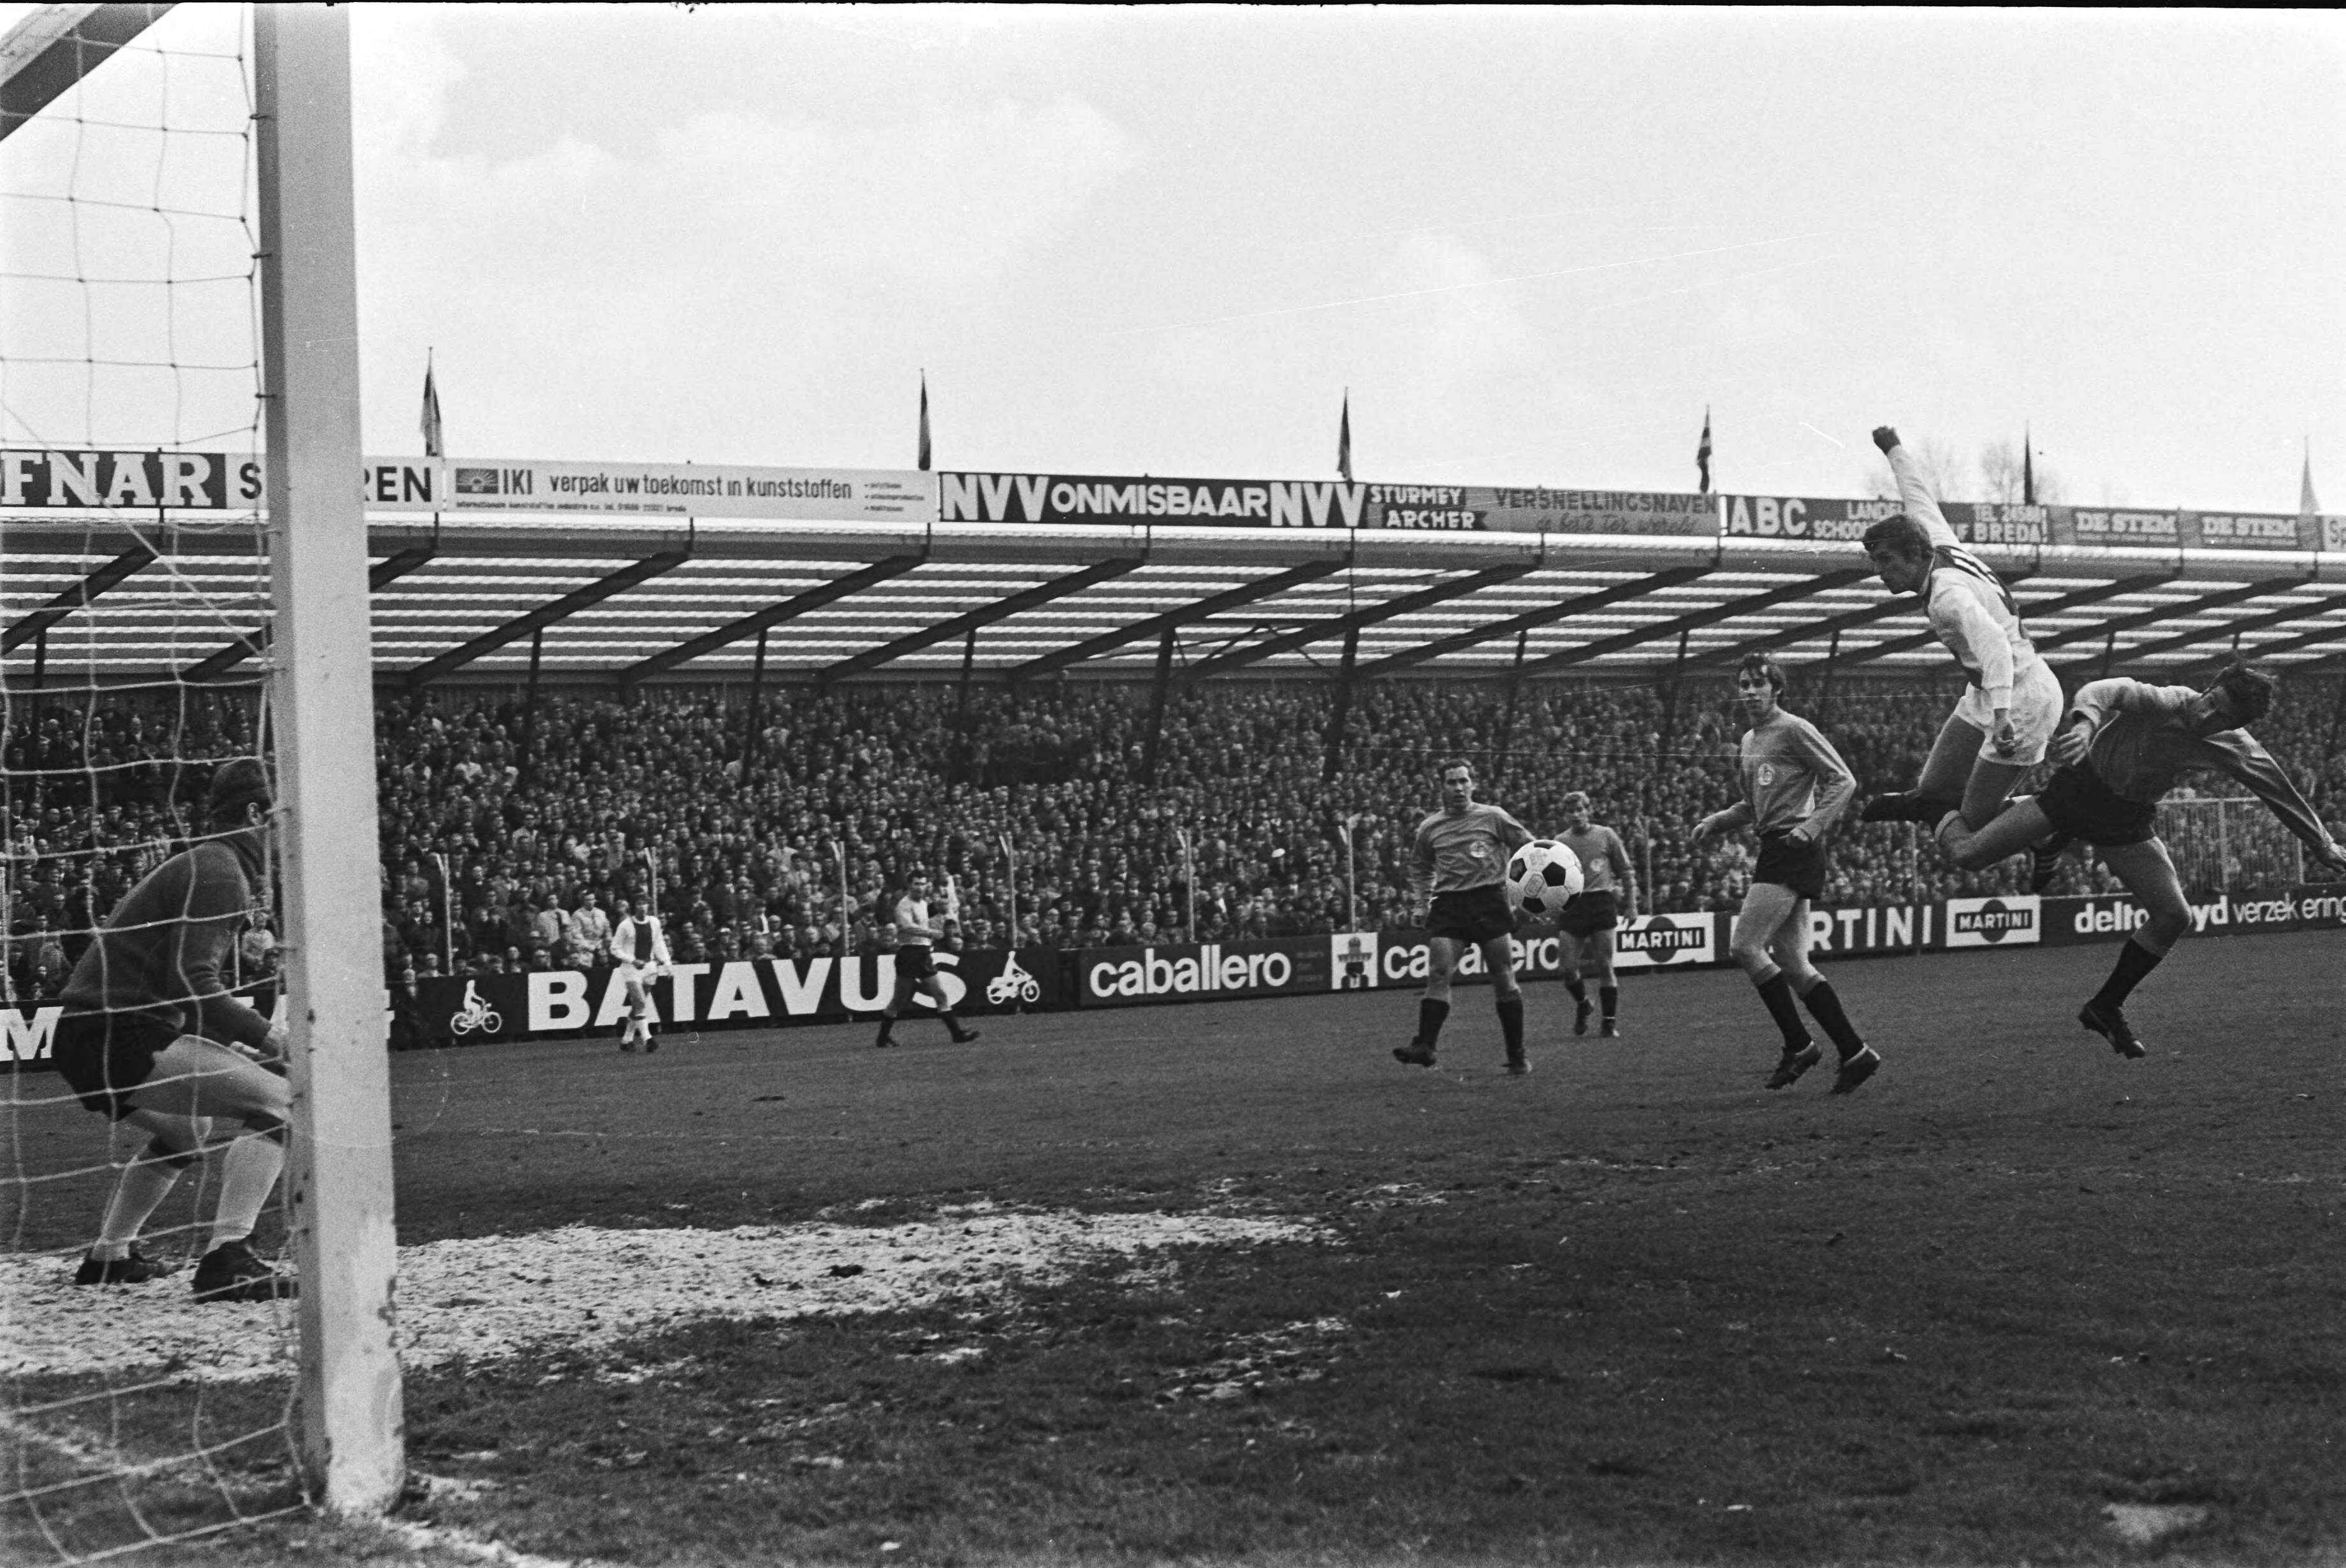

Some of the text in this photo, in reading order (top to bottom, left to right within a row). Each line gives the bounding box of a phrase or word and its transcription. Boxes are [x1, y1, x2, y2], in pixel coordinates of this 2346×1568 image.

[504, 469, 532, 495] IKI
[550, 473, 852, 498] verpak uw toekomst in kunststoffen
[942, 474, 1366, 526] NVV ONMISBAAR NVV
[1371, 486, 1461, 505] STURMEY
[1387, 509, 1475, 528] ARCHER
[1974, 522, 2041, 542] BREDA
[1960, 911, 2029, 930] MARTINI
[1622, 929, 1700, 949] MARTINI
[1090, 945, 1292, 998] caballero
[528, 952, 966, 1031] BATAVUS
